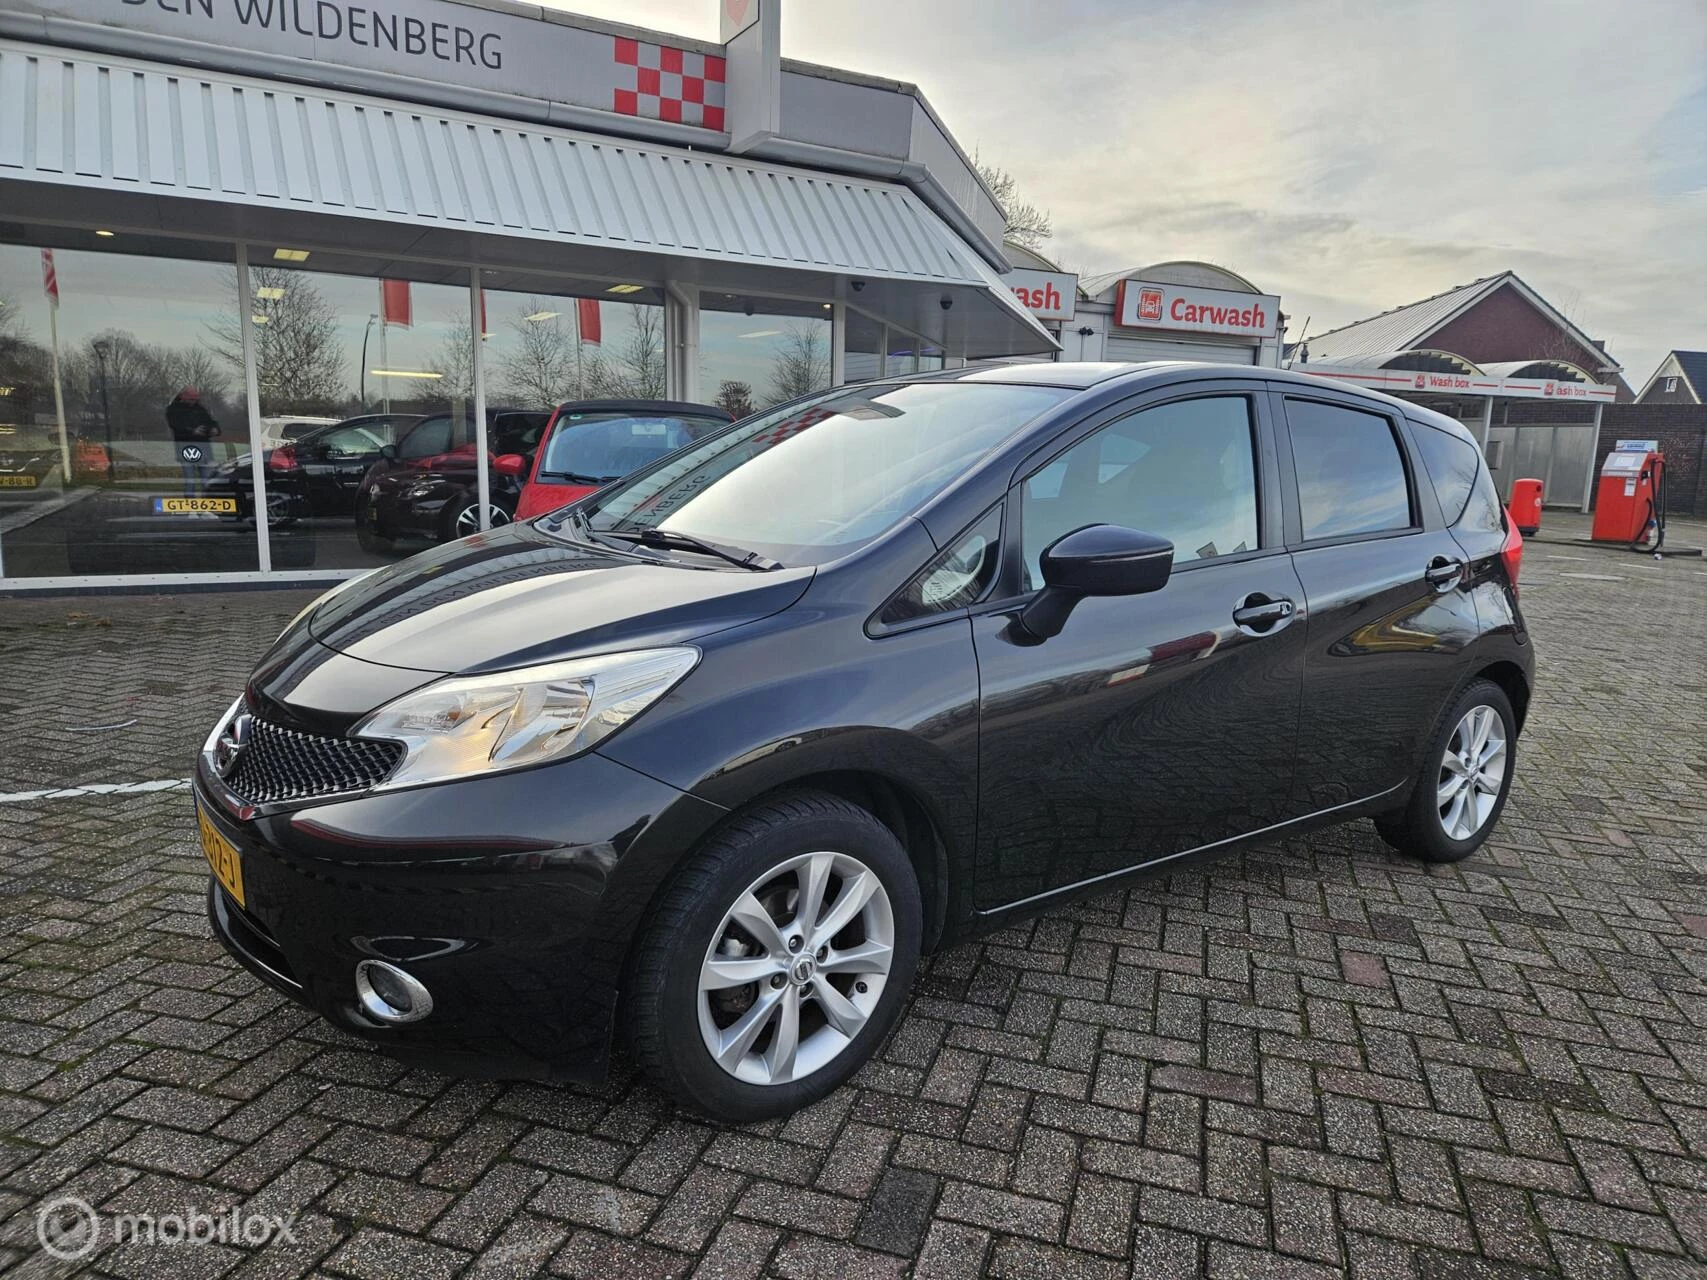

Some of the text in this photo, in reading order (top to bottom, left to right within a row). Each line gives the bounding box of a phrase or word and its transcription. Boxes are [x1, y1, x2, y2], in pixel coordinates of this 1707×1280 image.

[234, 0, 501, 69] WILDENBERG
[1011, 281, 1061, 310] ash
[1170, 298, 1265, 328] Carwash
[1430, 376, 1469, 388] Wash box
[167, 500, 231, 510] GT-862-D
